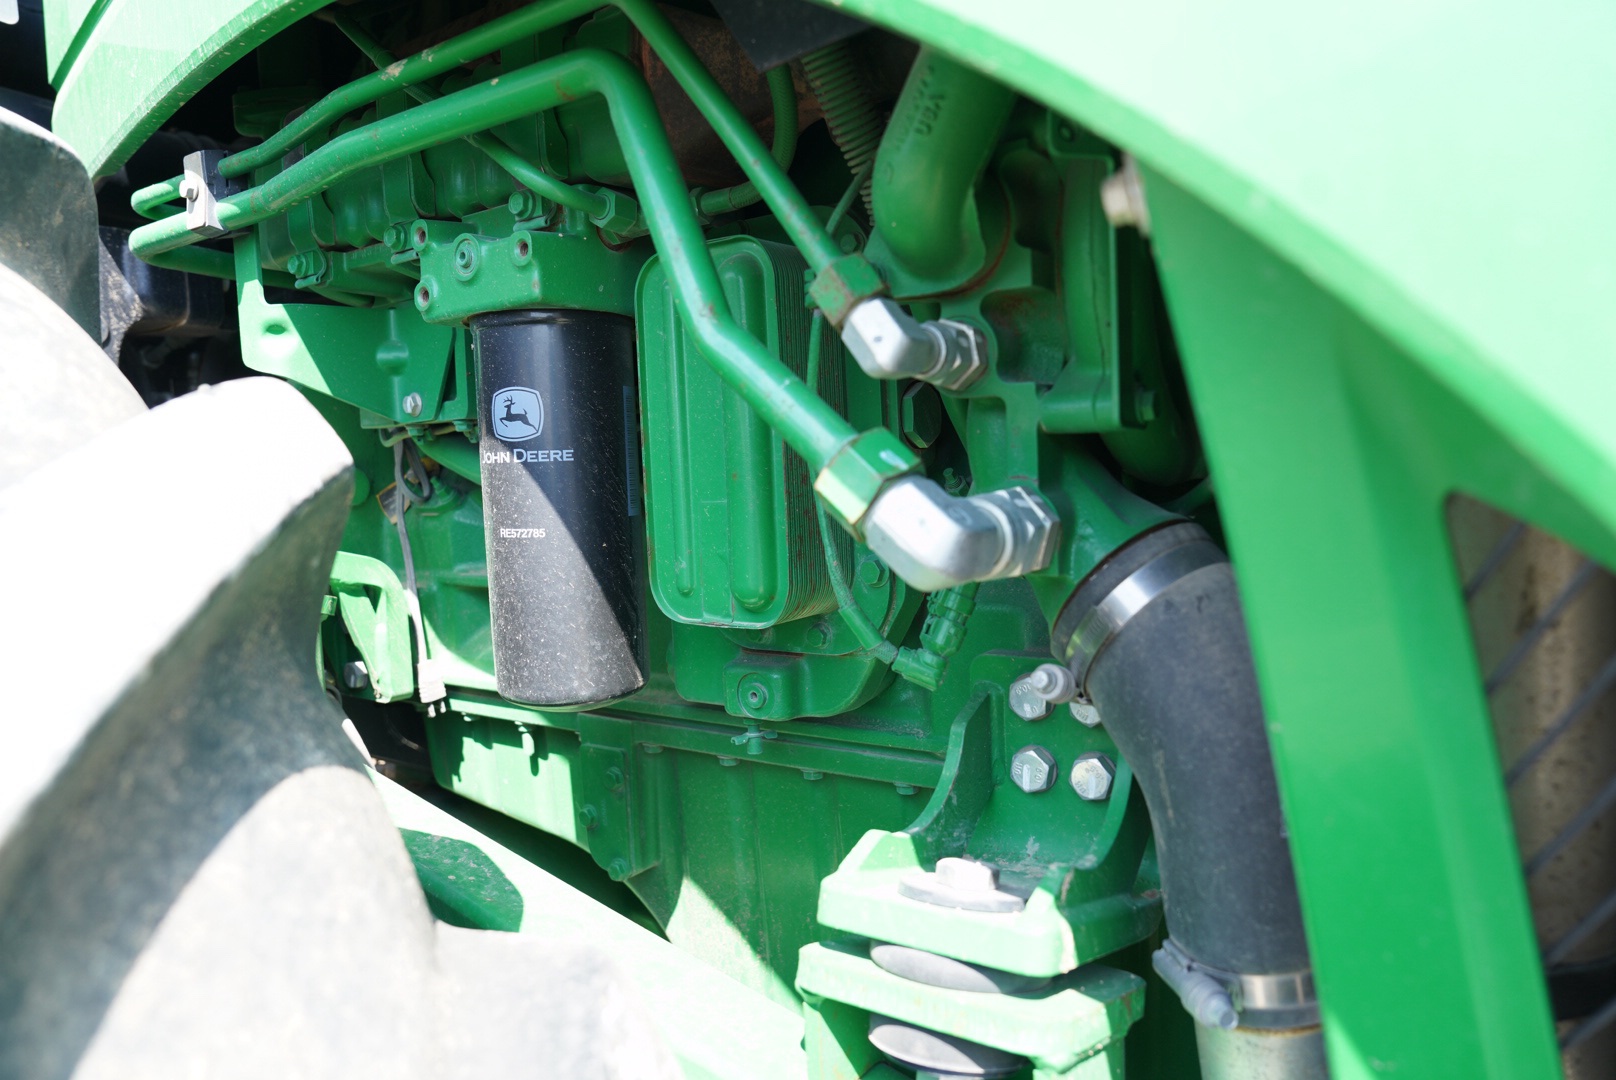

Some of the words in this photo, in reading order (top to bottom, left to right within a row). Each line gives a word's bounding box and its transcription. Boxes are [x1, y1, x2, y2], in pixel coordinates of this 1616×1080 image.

[482, 450, 511, 464] JOHN
[513, 448, 575, 463] DEERE
[500, 528, 546, 539] RE572785
